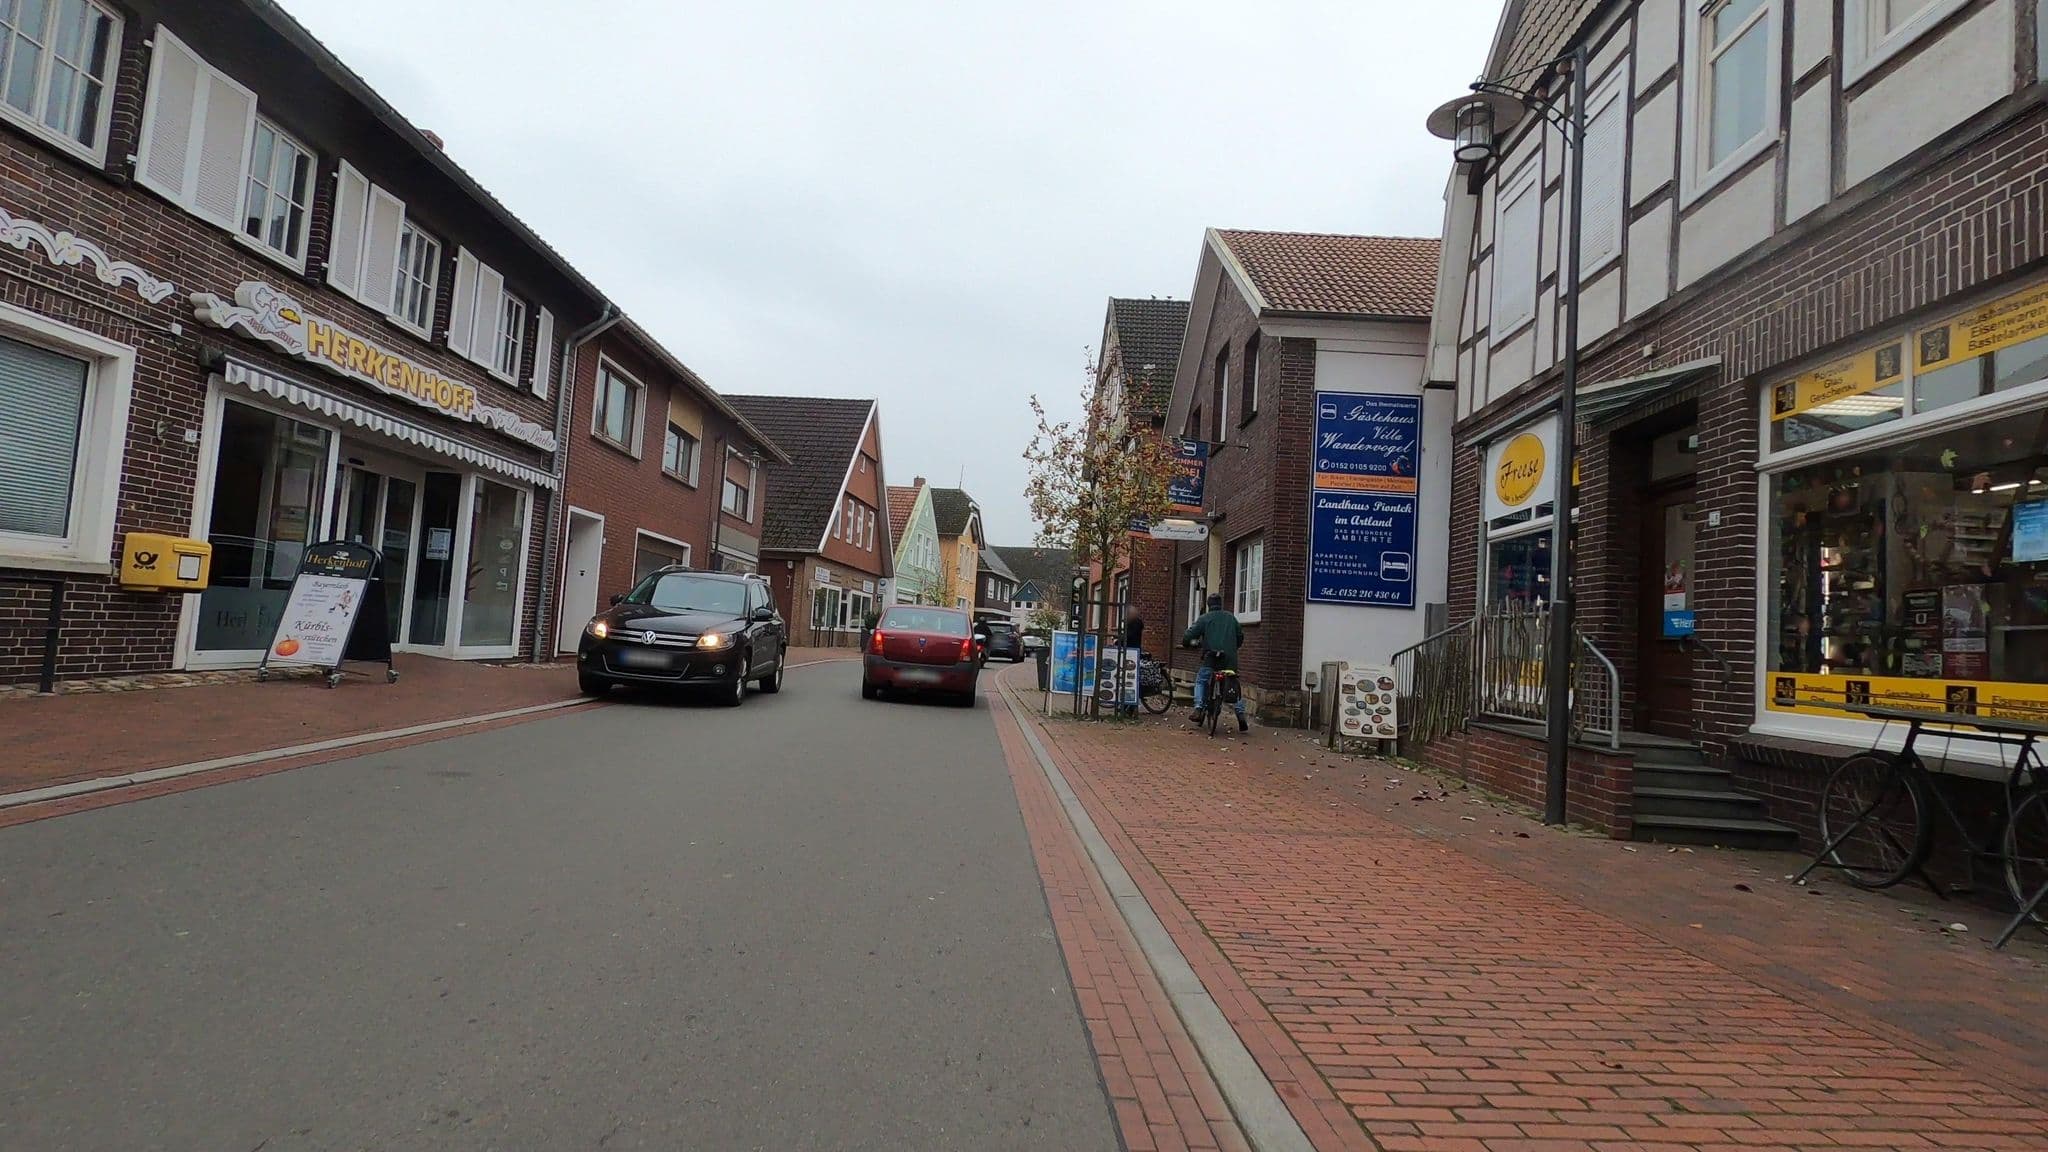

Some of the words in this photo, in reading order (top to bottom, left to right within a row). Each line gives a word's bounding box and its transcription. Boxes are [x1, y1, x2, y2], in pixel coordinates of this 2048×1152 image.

[307, 319, 474, 416] HERKENHOFF
[1343, 405, 1416, 424] Gästehaus
[1373, 425, 1403, 441] Villa
[1319, 432, 1416, 458] Wandervogel
[1330, 461, 1349, 469] 0152
[1316, 498, 1370, 511] Landhaus
[1334, 515, 1348, 525] im
[1350, 515, 1393, 528] Artland
[1333, 534, 1393, 544] AMBIENTE
[307, 553, 369, 570] Herkenhoff
[1314, 552, 1358, 560] APARTMENT
[1314, 567, 1379, 577] FERIENWOHNUNG
[1338, 588, 1358, 597] 0152
[1359, 590, 1372, 598] 210
